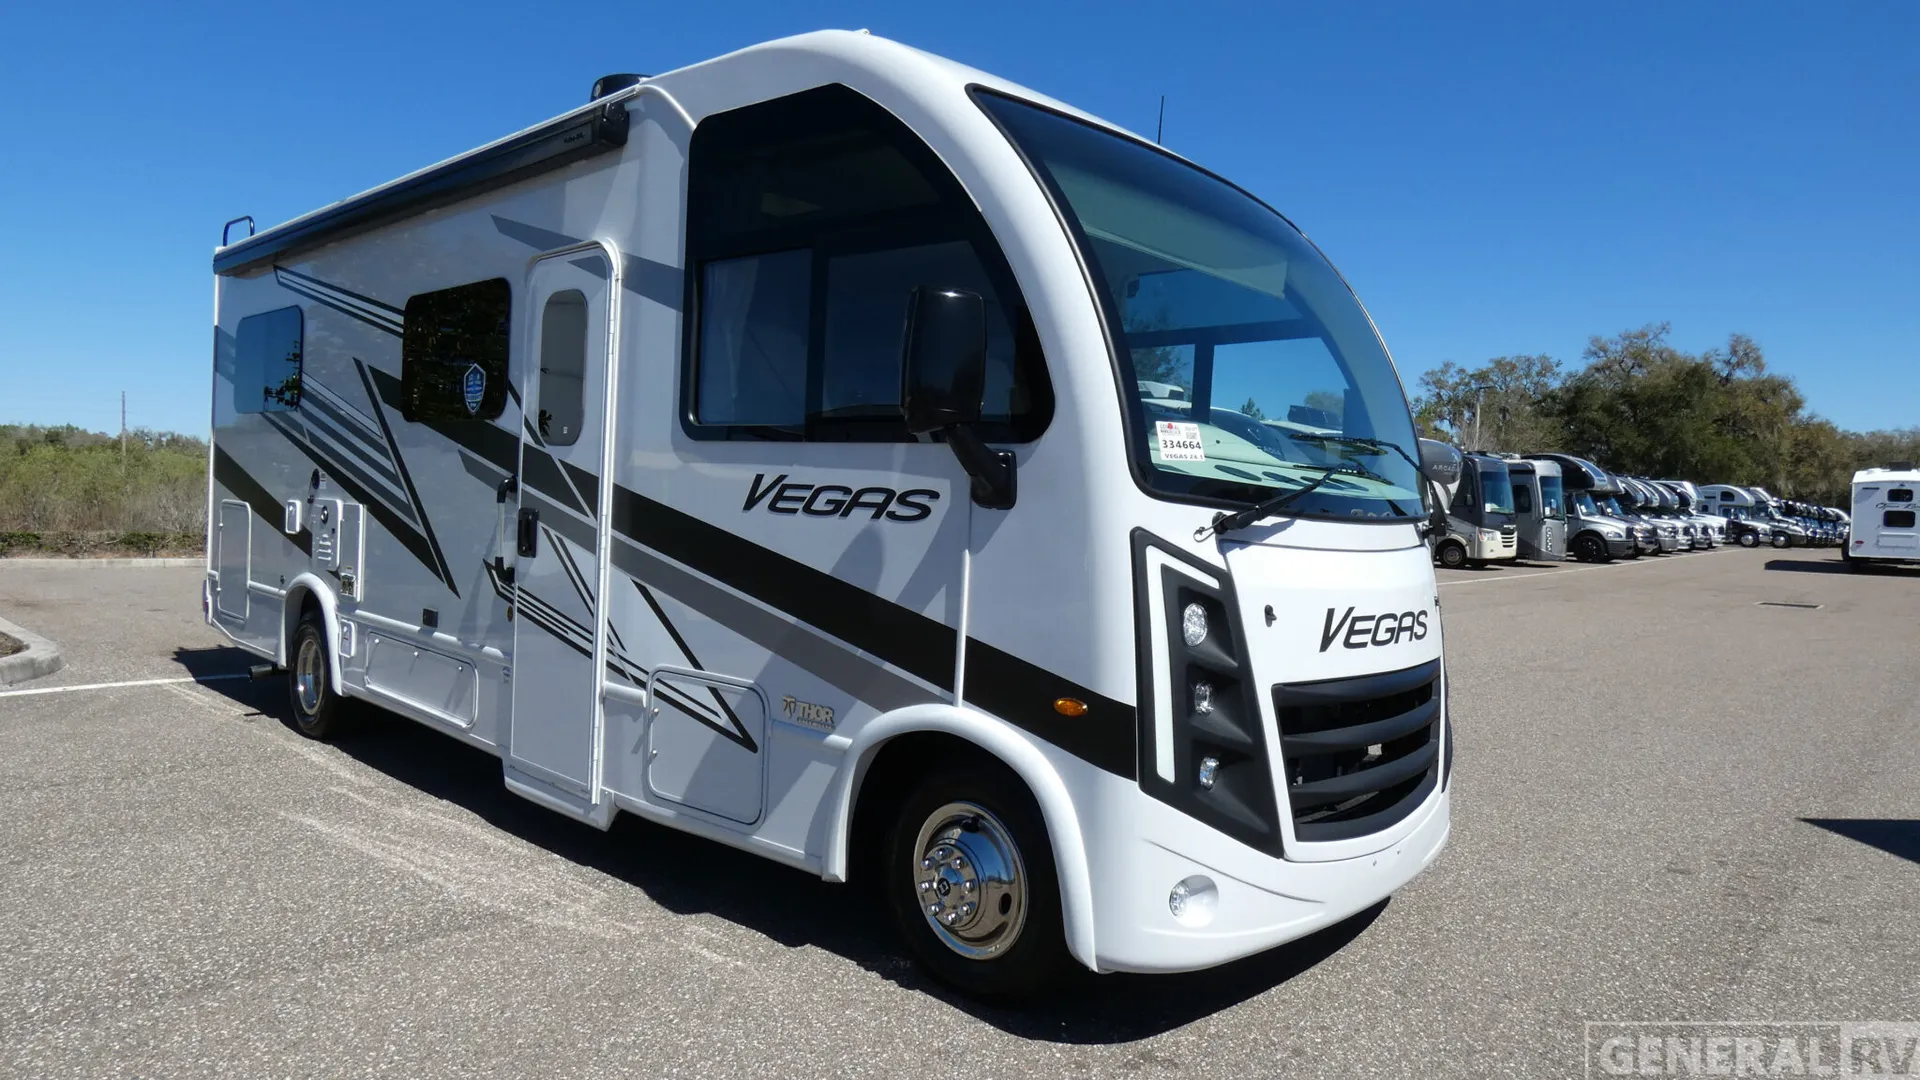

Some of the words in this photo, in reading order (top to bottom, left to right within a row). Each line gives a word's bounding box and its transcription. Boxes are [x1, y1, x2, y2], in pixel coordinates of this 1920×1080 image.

[1162, 439, 1202, 450] 334664
[742, 473, 941, 522] VEGAS
[1319, 606, 1428, 653] VEGAS
[796, 701, 835, 724] THOR
